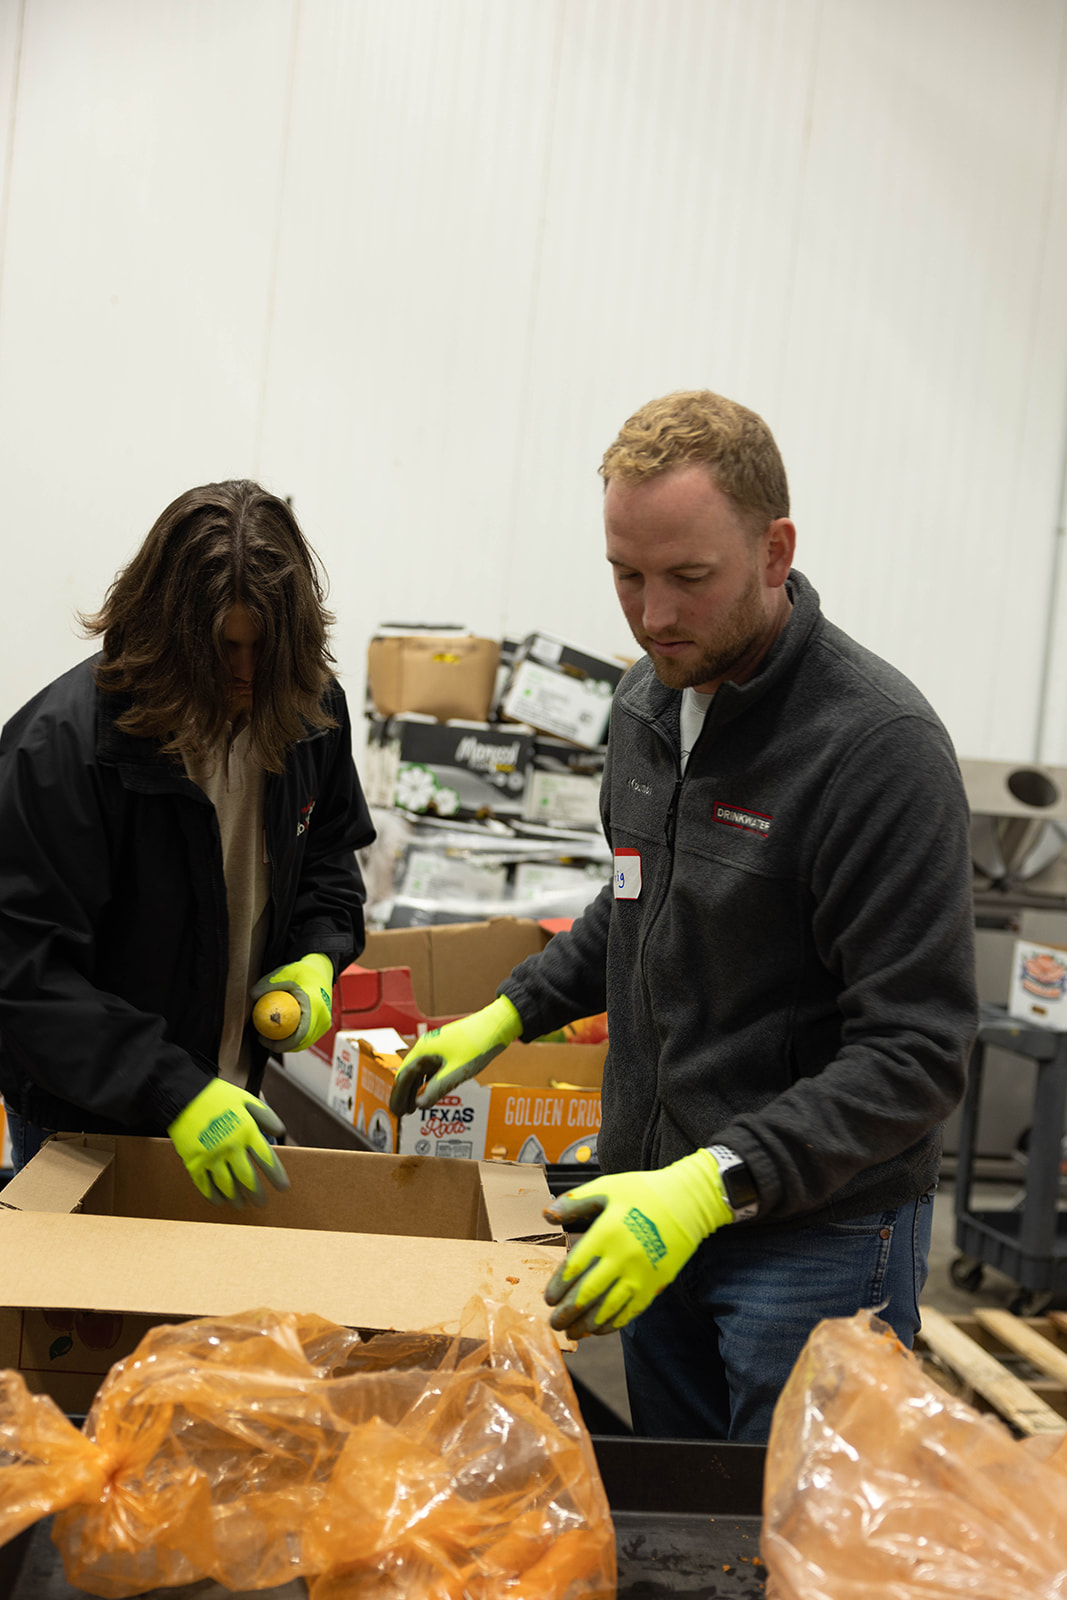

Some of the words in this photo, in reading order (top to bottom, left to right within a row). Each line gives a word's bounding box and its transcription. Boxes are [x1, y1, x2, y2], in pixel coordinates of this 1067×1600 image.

[419, 1107, 475, 1123] TEXAS
[504, 1096, 565, 1127] GOLDEN
[420, 1116, 466, 1139] Roots
